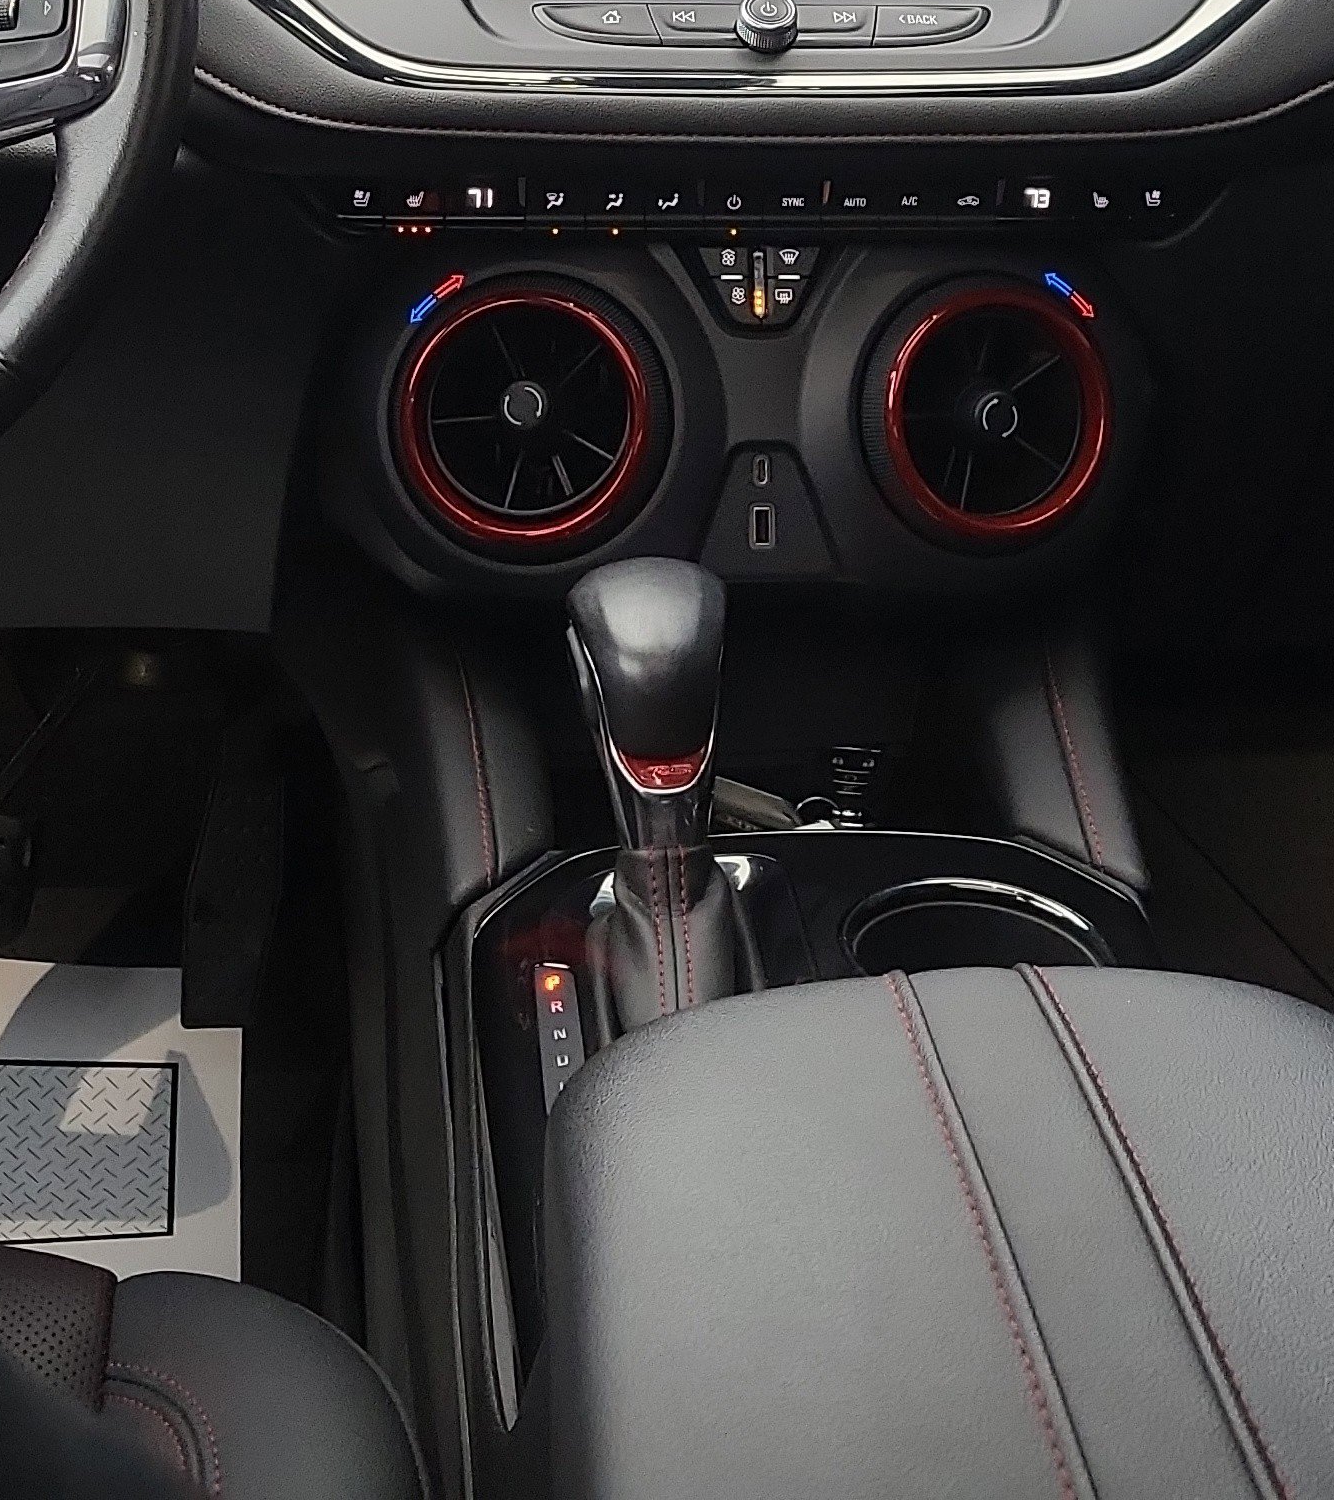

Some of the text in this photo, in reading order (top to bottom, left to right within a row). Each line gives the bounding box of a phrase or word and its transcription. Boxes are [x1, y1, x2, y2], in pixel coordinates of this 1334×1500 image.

[907, 13, 938, 25] BACK
[468, 187, 493, 208] 71
[781, 197, 805, 207] SYNC
[843, 197, 867, 207] AUTO
[901, 195, 918, 206] A/C
[1024, 188, 1051, 209] 73
[544, 974, 561, 991] P
[550, 1000, 564, 1013] R
[553, 1027, 567, 1040] N
[556, 1054, 569, 1067] D
